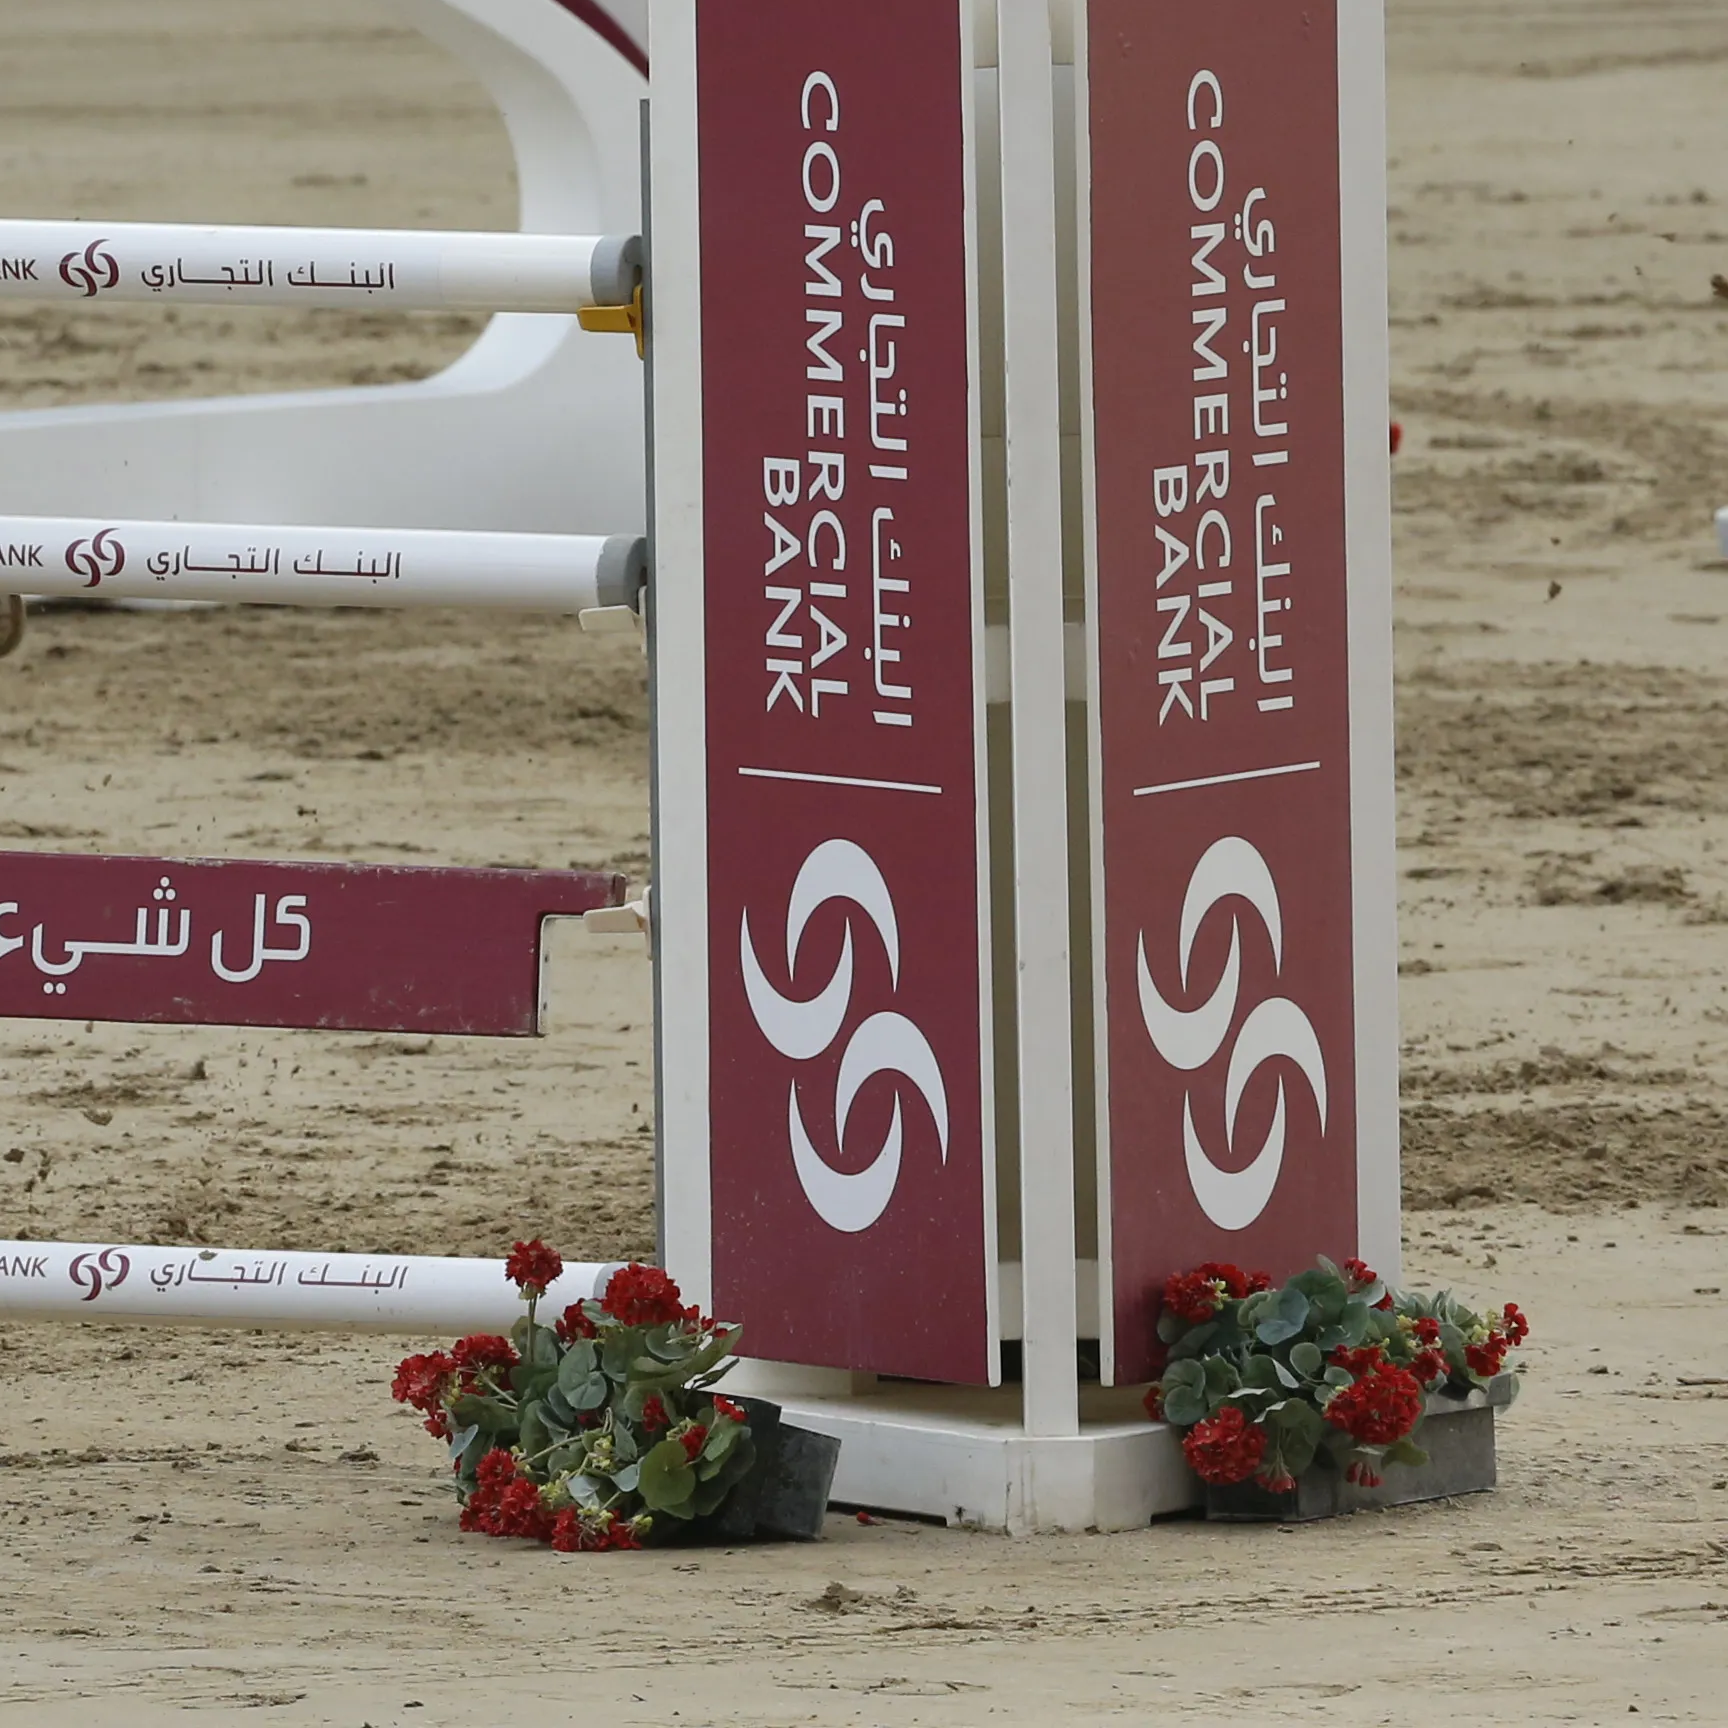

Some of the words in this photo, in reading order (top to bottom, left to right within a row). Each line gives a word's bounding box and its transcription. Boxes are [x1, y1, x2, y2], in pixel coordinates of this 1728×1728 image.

[140, 257, 274, 293] التجاري
[286, 260, 395, 295] البنك
[850, 198, 908, 480] التجاري
[1234, 187, 1288, 466] التجاري
[798, 70, 849, 719] COMMERCIAL
[1183, 69, 1235, 721] COMMERCIAL
[146, 544, 281, 582] التجاري
[292, 548, 402, 585] البنك
[762, 456, 804, 714] BANK
[864, 507, 913, 727] البنك
[1153, 465, 1196, 725] BANK
[1248, 494, 1294, 712] البنك
[211, 893, 311, 983] كل
[149, 1258, 288, 1293] التجاري
[297, 1262, 410, 1295] البنك
